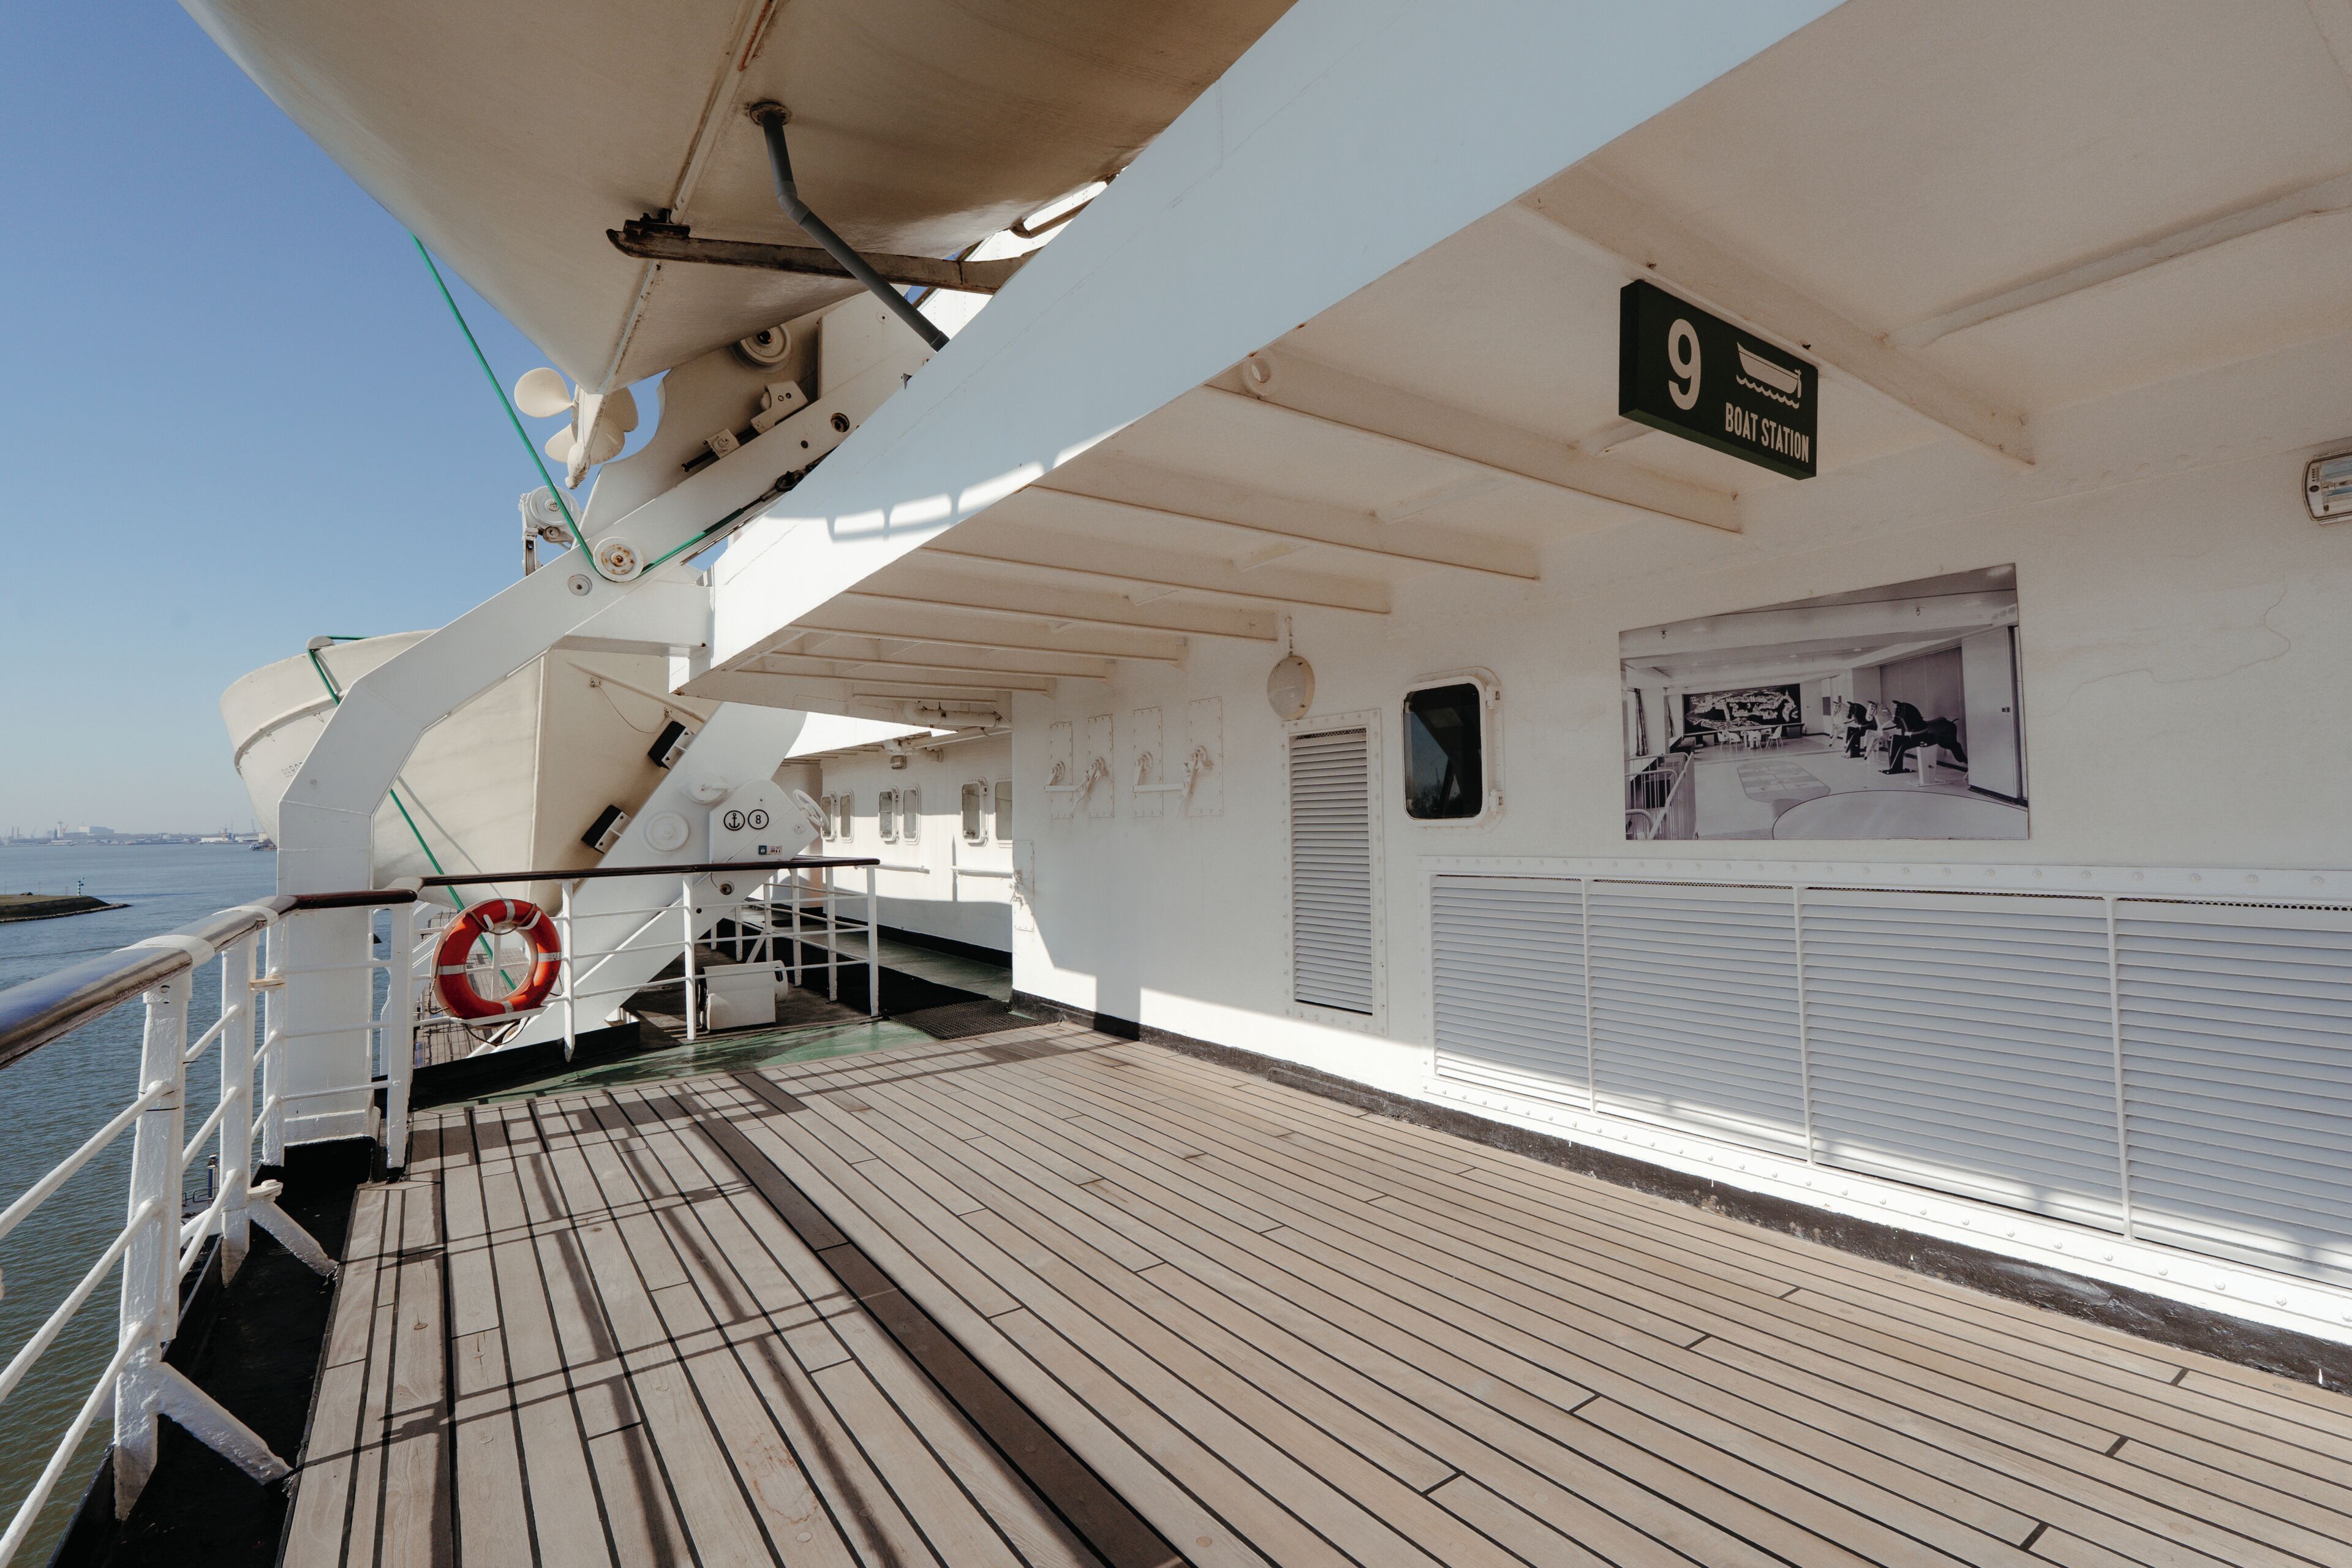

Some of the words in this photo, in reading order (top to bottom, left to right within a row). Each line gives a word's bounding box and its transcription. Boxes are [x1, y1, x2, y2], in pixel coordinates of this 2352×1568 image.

[1668, 318, 1701, 410] 9
[1725, 402, 1758, 442] BOAT
[1762, 418, 1809, 463] STATION
[756, 815, 761, 824] 8
